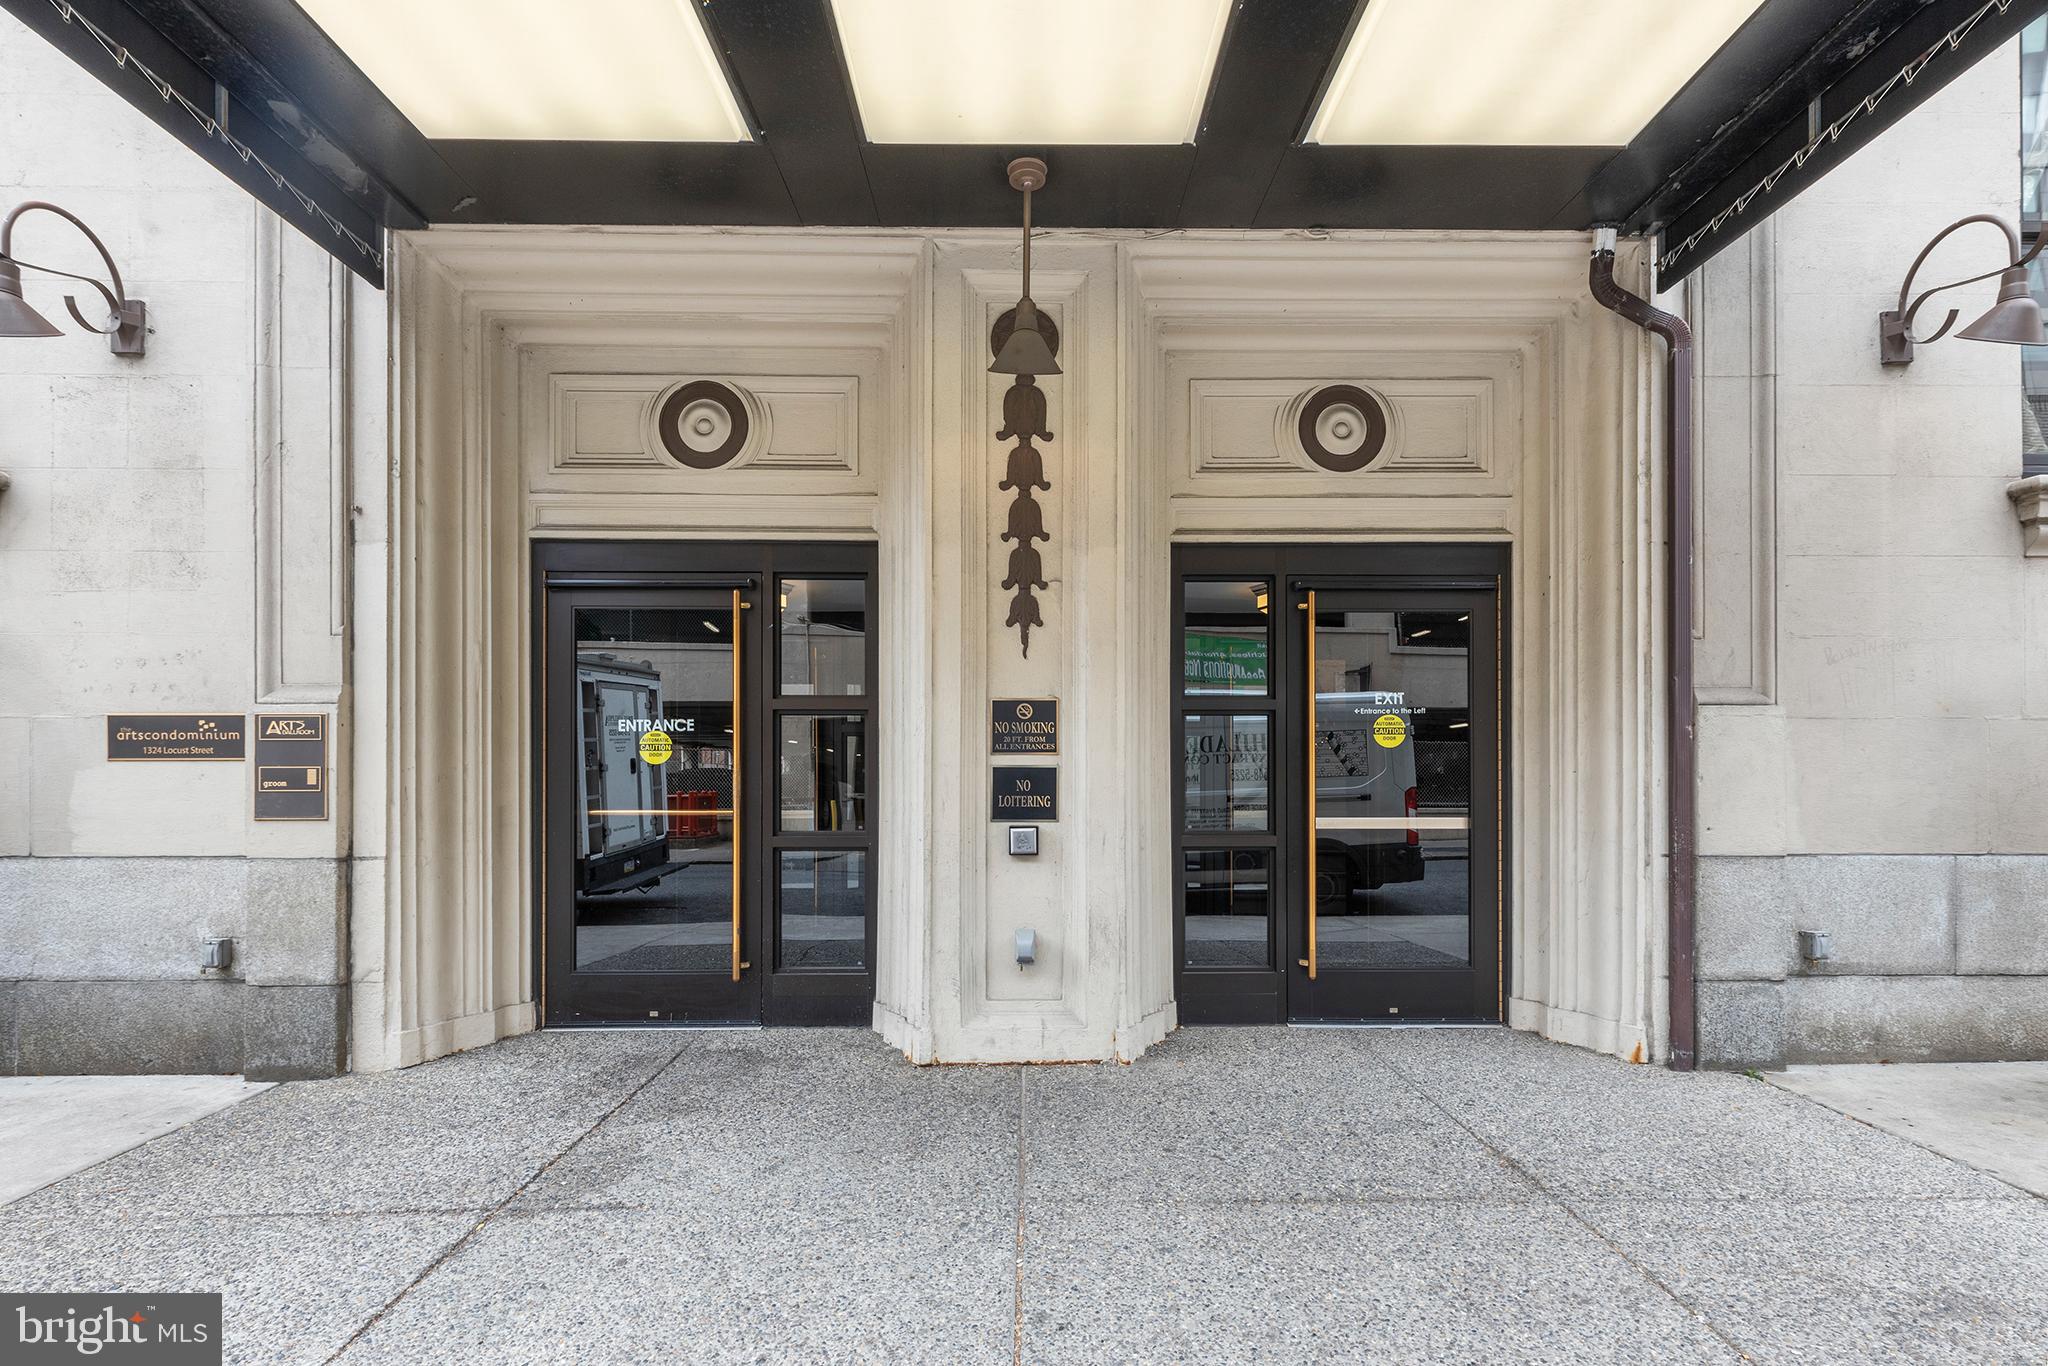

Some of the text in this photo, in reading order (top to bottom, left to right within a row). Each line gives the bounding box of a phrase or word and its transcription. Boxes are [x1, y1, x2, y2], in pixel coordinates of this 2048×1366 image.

[1375, 692, 1405, 705] EXIT
[266, 720, 305, 735] ARTS
[618, 718, 695, 732] ENTRANCE
[994, 721, 1055, 734] NO SMOKING
[116, 728, 240, 741] artscondominium
[143, 746, 214, 754] 1324 Locust Street
[1016, 779, 1031, 792] NO
[998, 795, 1051, 808] LOITERING
